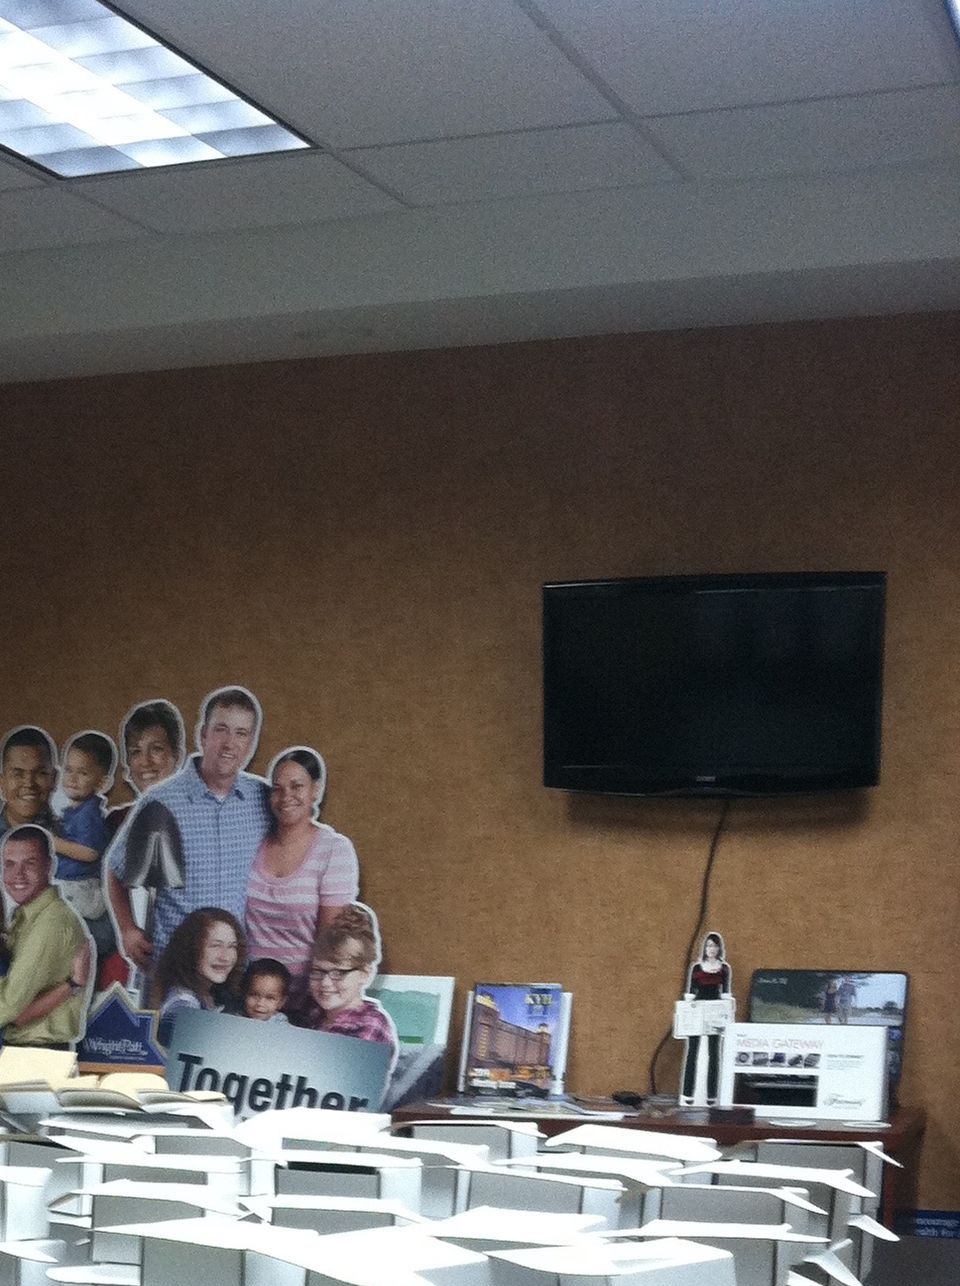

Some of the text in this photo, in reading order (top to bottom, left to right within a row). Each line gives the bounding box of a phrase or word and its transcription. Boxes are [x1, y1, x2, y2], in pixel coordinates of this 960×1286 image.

[737, 1039, 825, 1050] MEDIA GATEWAY
[177, 1052, 370, 1116] Together
